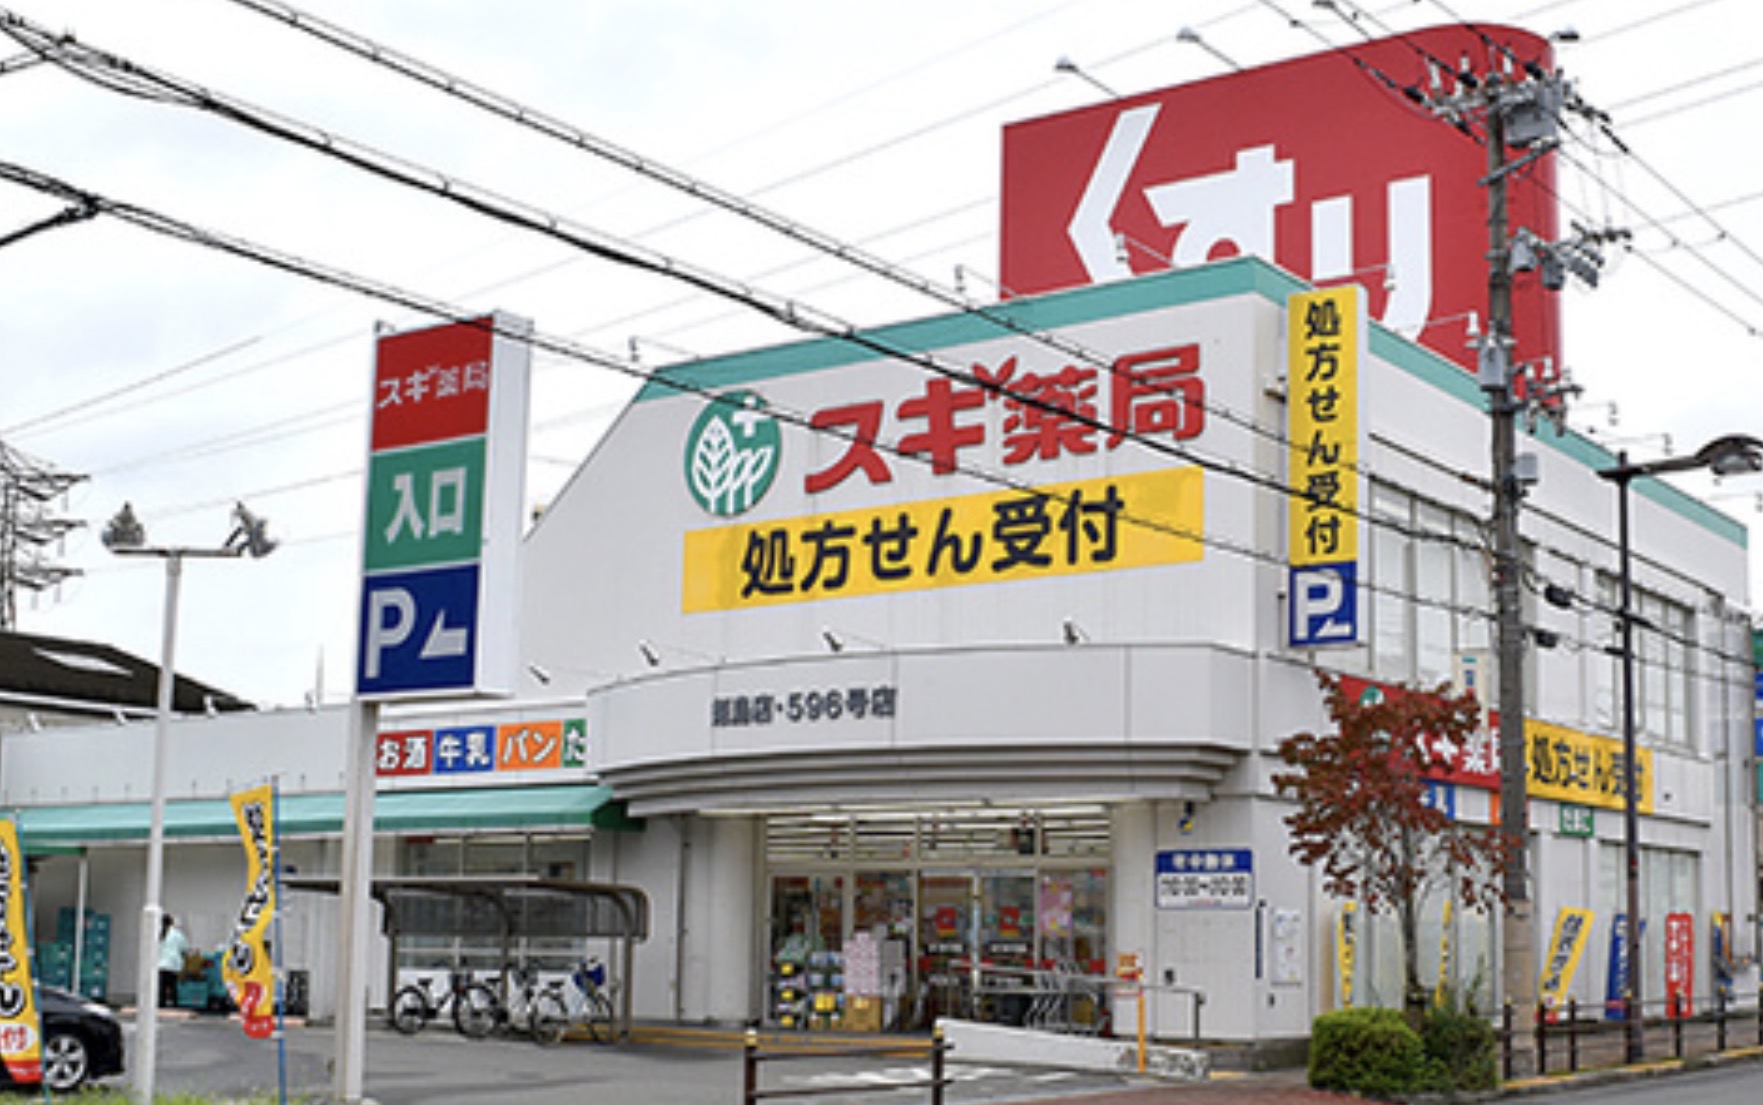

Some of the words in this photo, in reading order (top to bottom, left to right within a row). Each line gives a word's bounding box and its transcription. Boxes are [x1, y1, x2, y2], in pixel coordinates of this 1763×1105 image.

[1068, 103, 1431, 342] くすり
[804, 343, 1204, 494] スギ薬局
[1304, 299, 1341, 555] 処方せん受付
[384, 467, 467, 545] 入口
[742, 485, 1124, 597] 処方せん受付
[364, 588, 416, 679] P
[1294, 569, 1343, 641] P
[379, 735, 427, 769] お酒
[439, 732, 489, 768] 牛乳
[503, 728, 556, 762] パン
